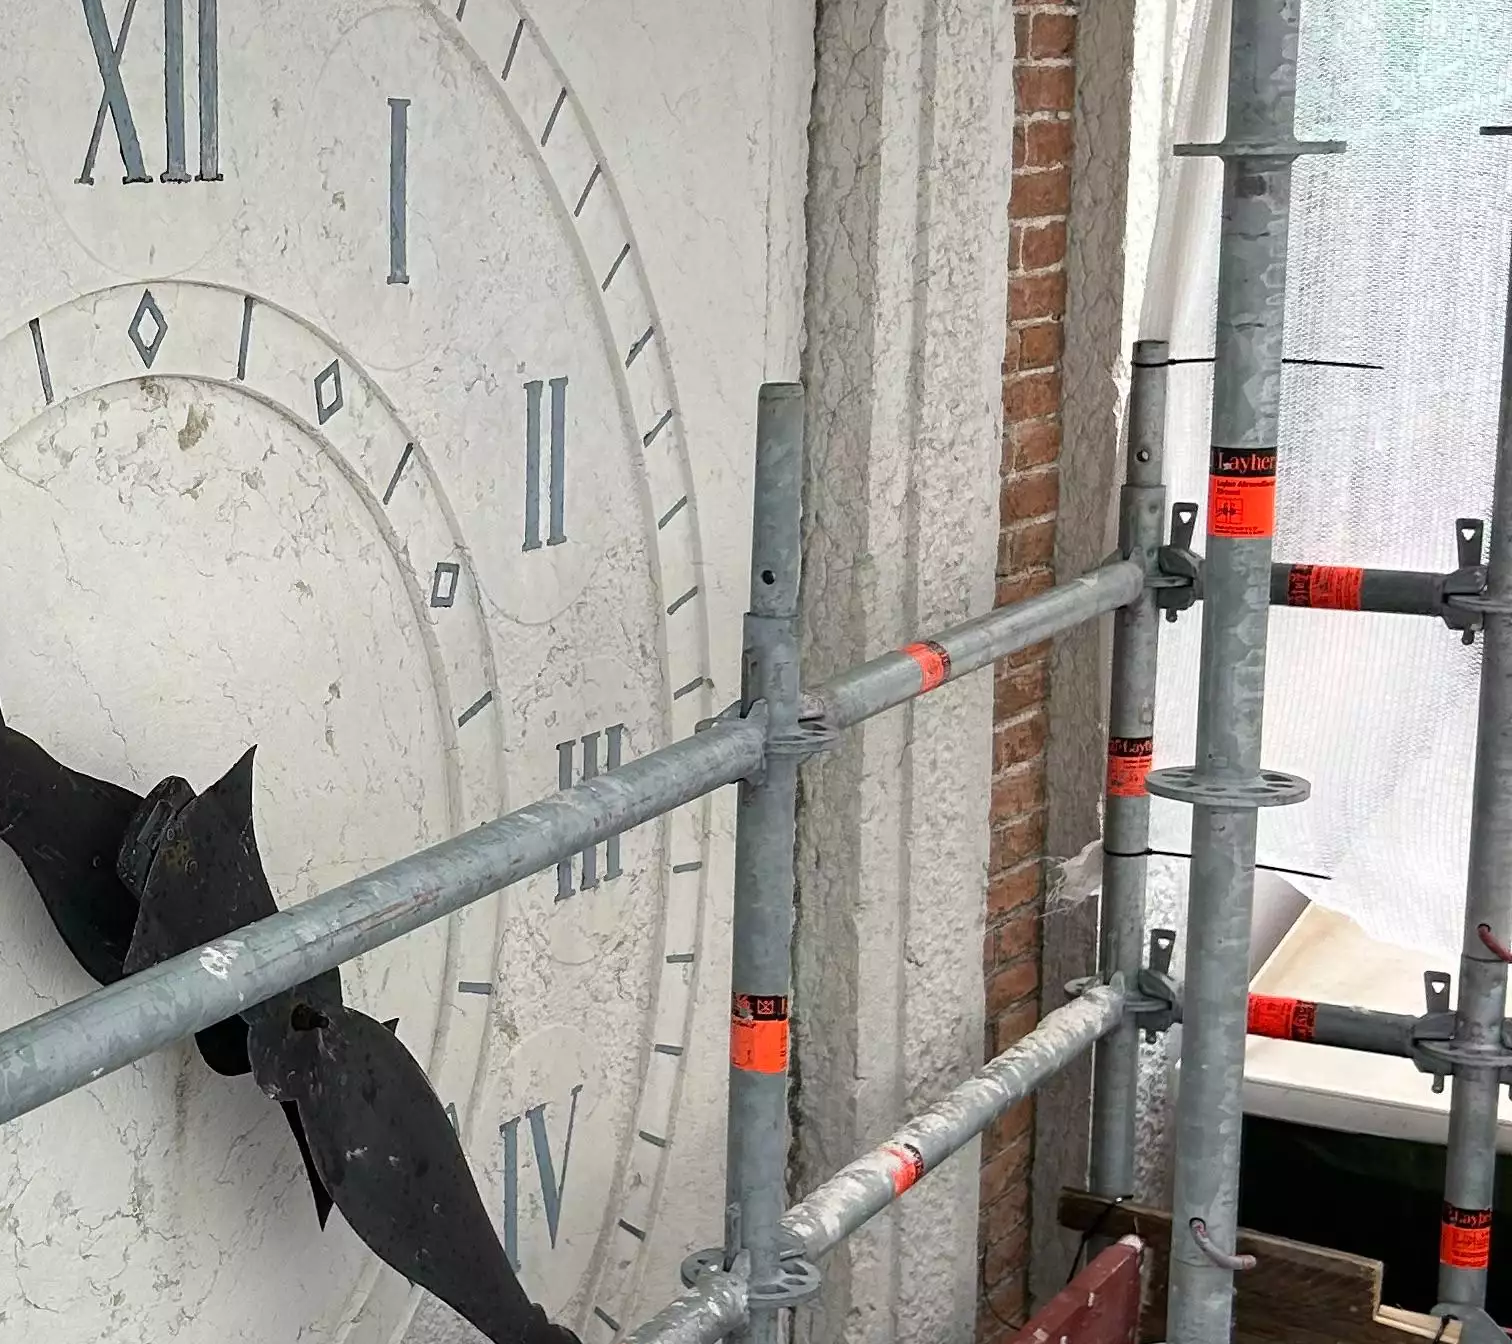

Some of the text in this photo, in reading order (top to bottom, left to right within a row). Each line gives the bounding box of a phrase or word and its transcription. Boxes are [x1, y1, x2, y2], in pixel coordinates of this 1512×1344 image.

[387, 98, 411, 285] I
[522, 376, 569, 552] II
[499, 1084, 584, 1273] IV
